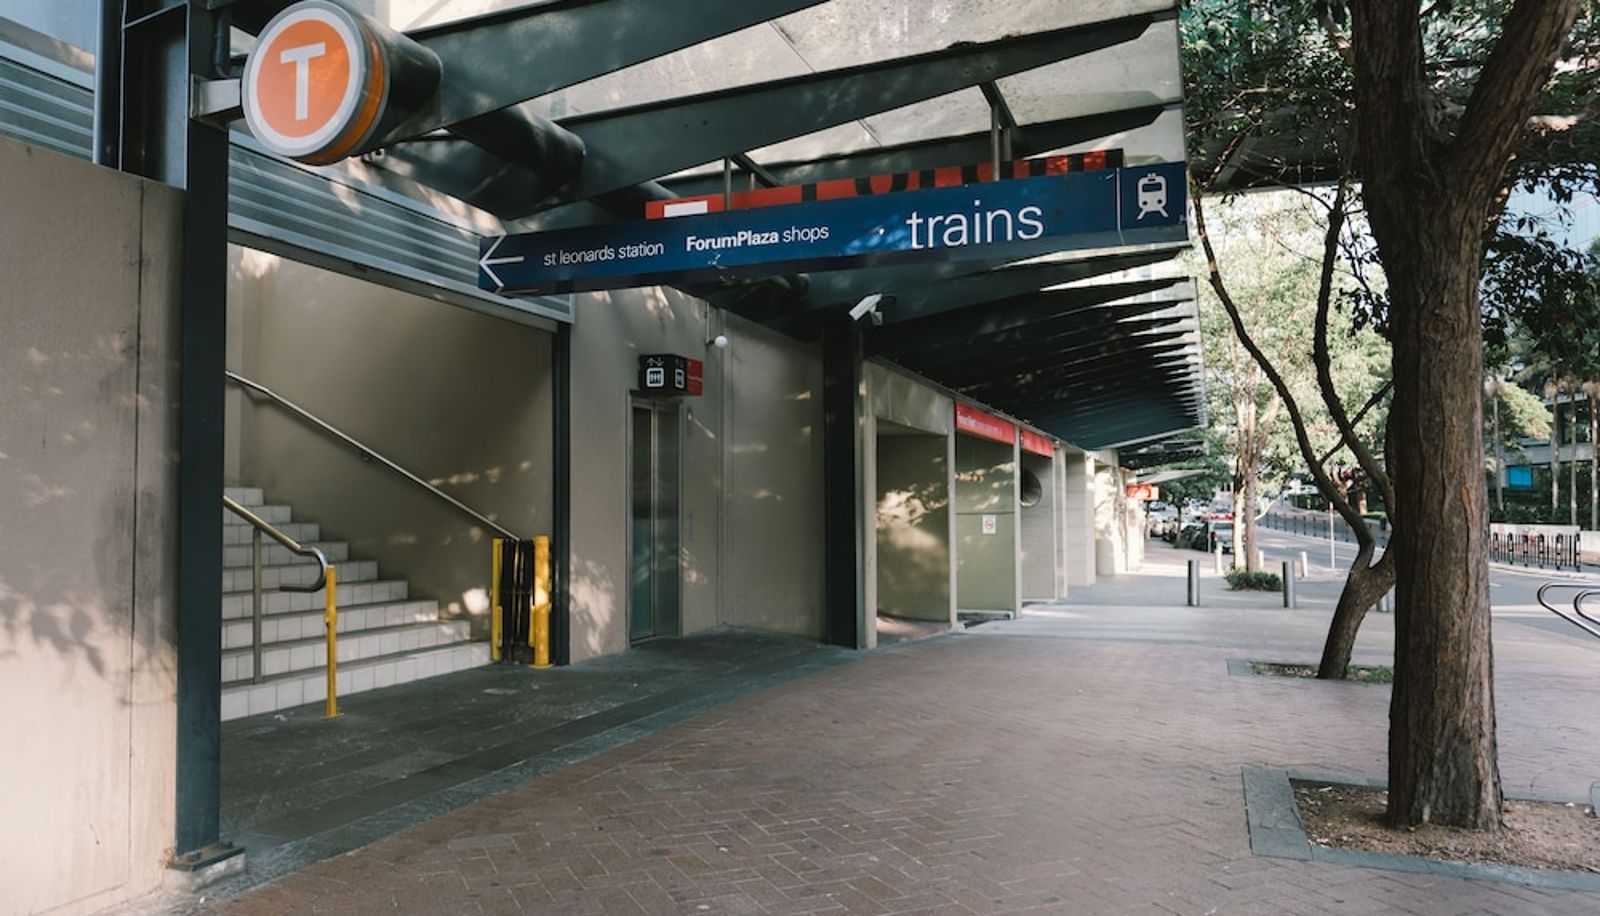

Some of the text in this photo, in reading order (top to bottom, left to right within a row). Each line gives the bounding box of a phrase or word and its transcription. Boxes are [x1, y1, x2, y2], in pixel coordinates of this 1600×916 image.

[280, 42, 326, 121] T
[686, 224, 830, 251] ForumPlaza shops
[905, 200, 1044, 249] trains
[543, 240, 664, 266] st leonards station
